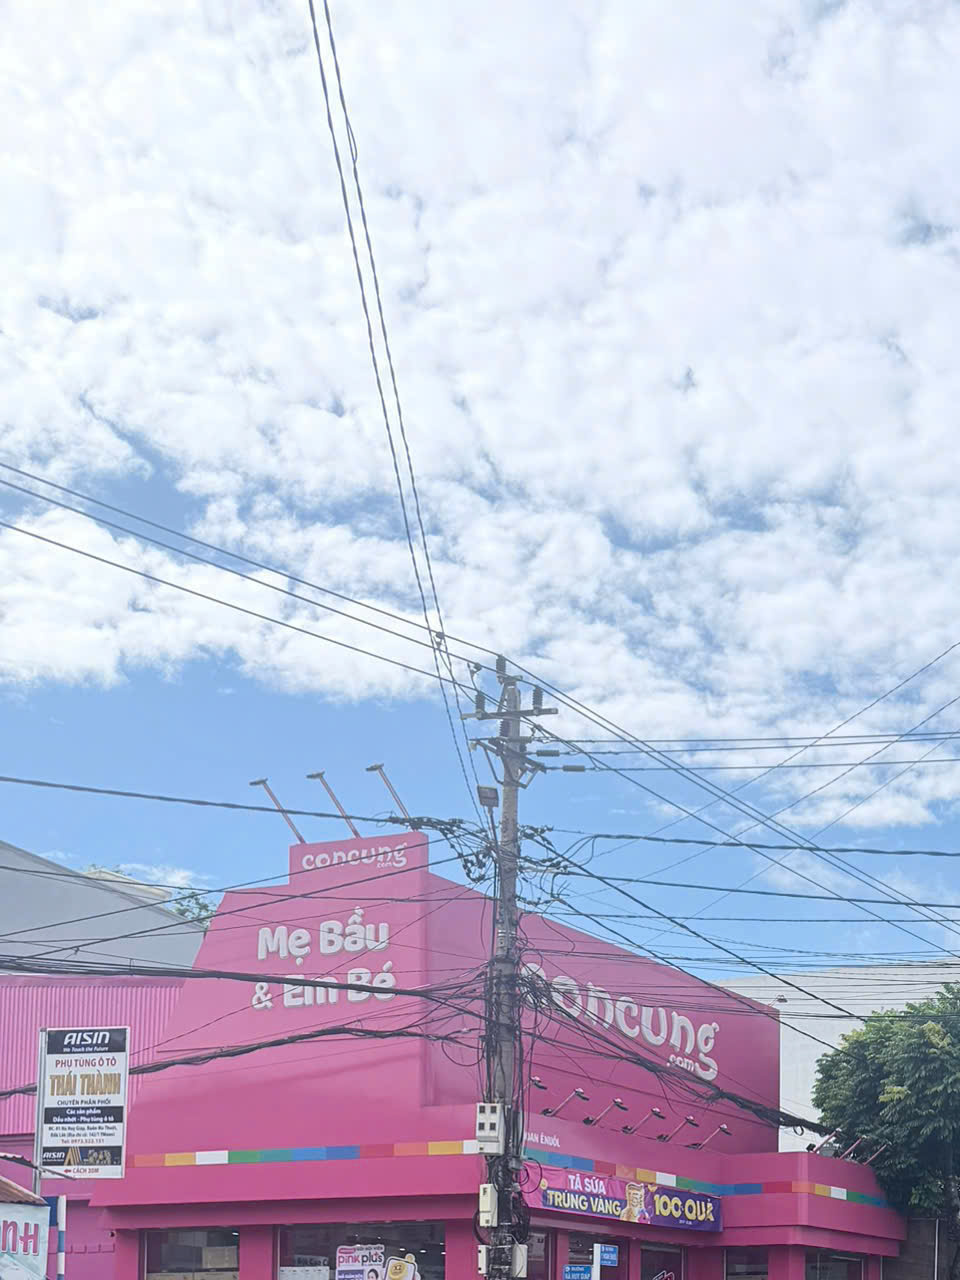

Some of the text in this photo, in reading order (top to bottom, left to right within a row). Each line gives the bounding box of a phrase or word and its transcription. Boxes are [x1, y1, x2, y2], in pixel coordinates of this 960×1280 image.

[302, 842, 408, 870] concung
[257, 905, 390, 966] Mẹ Bầu
[252, 960, 397, 1010] & Em Bé
[64, 1031, 110, 1045] AISIN
[55, 1055, 117, 1069] PHỤ TÙNG Ô TÔ
[666, 1054, 695, 1073] .com
[49, 1069, 121, 1096] THÁI THÀNH
[43, 1151, 66, 1159] AISIN
[590, 1194, 622, 1216] VÀNG
[361, 1251, 384, 1267] plus
